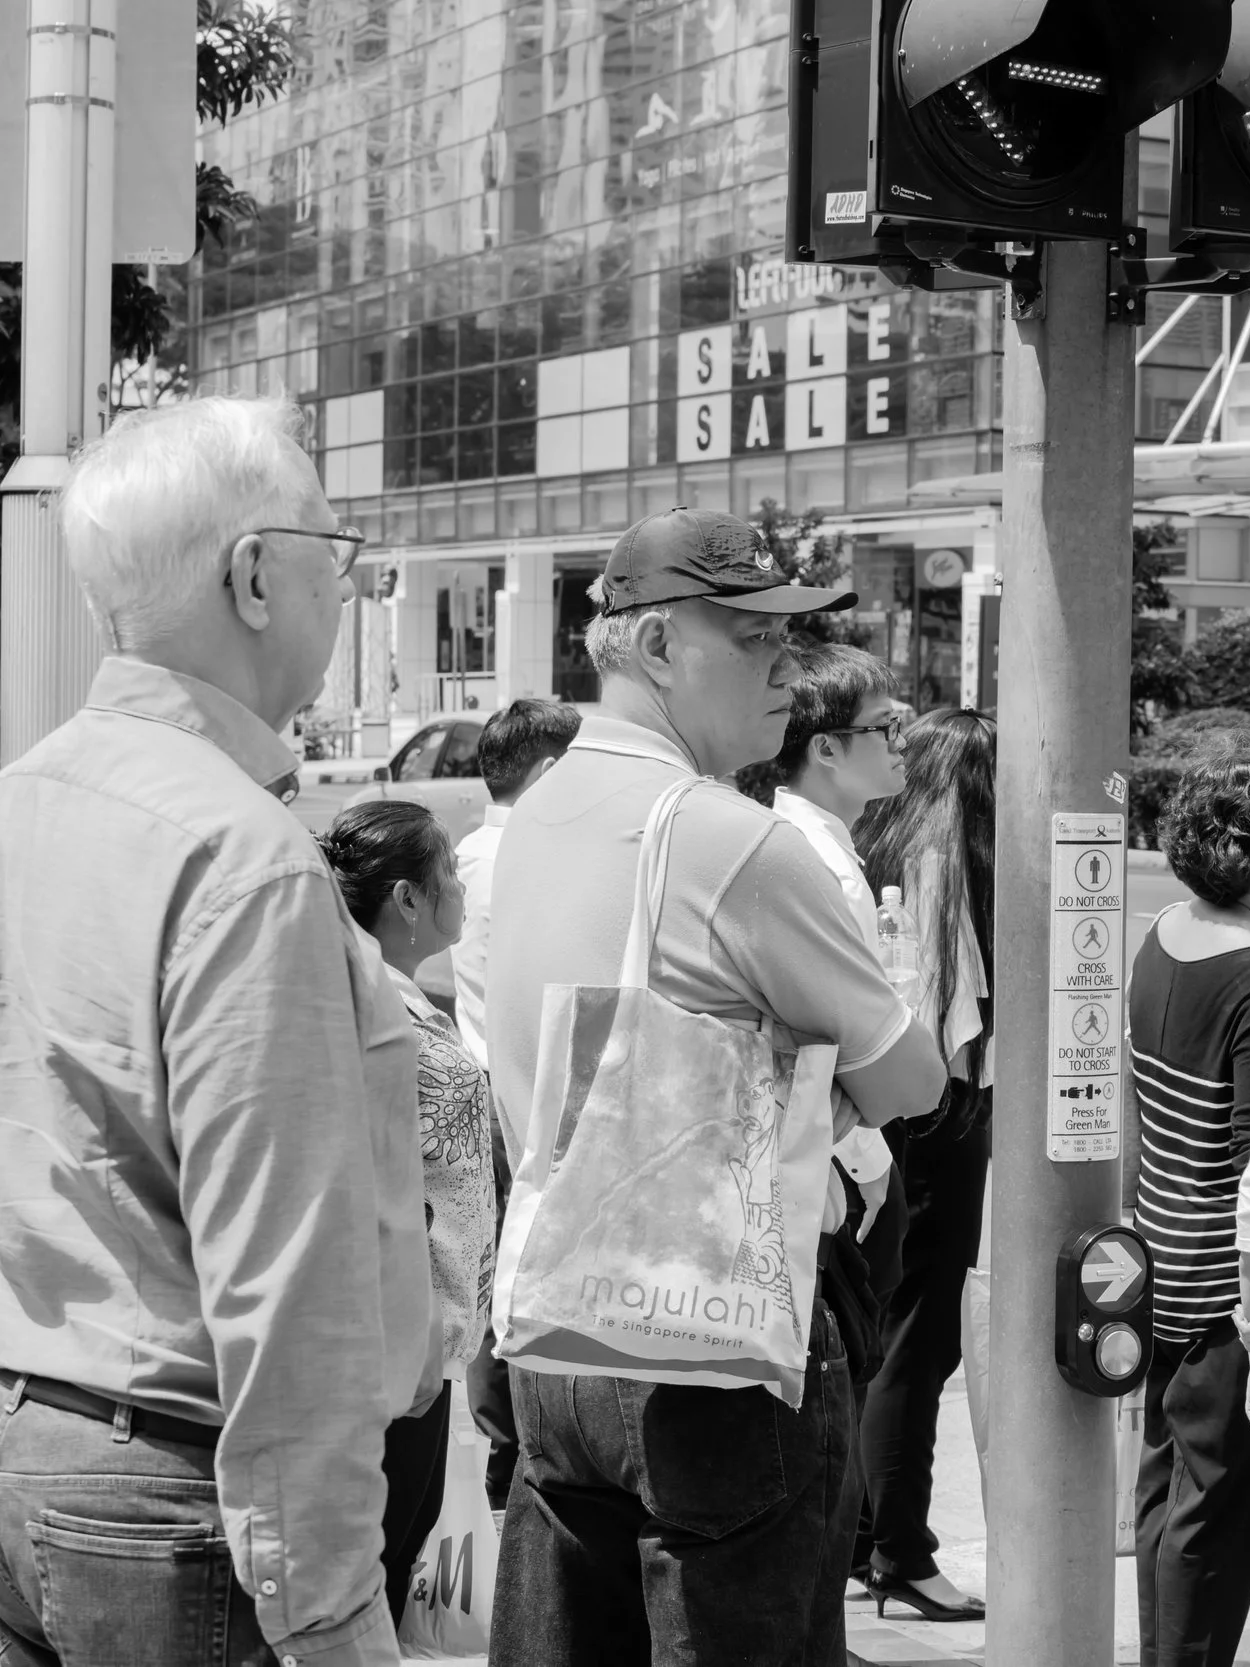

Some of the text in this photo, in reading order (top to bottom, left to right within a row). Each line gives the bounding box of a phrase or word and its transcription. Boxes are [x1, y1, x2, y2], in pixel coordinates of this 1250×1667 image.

[829, 193, 864, 214] ADHD
[697, 303, 891, 385] SALE
[696, 376, 890, 452] SALE
[1058, 895, 1120, 907] DO NOT CROSS
[1077, 962, 1107, 974] CROSS
[1066, 974, 1114, 986] WITH CARE
[1059, 1046, 1117, 1059] DO NOT START
[1069, 1059, 1110, 1071] TO CROSS
[1072, 1106, 1107, 1118] Press For
[1065, 1118, 1111, 1131] Green Man
[580, 1274, 767, 1331] majulah!
[592, 1314, 743, 1349] The Singapore Spirit
